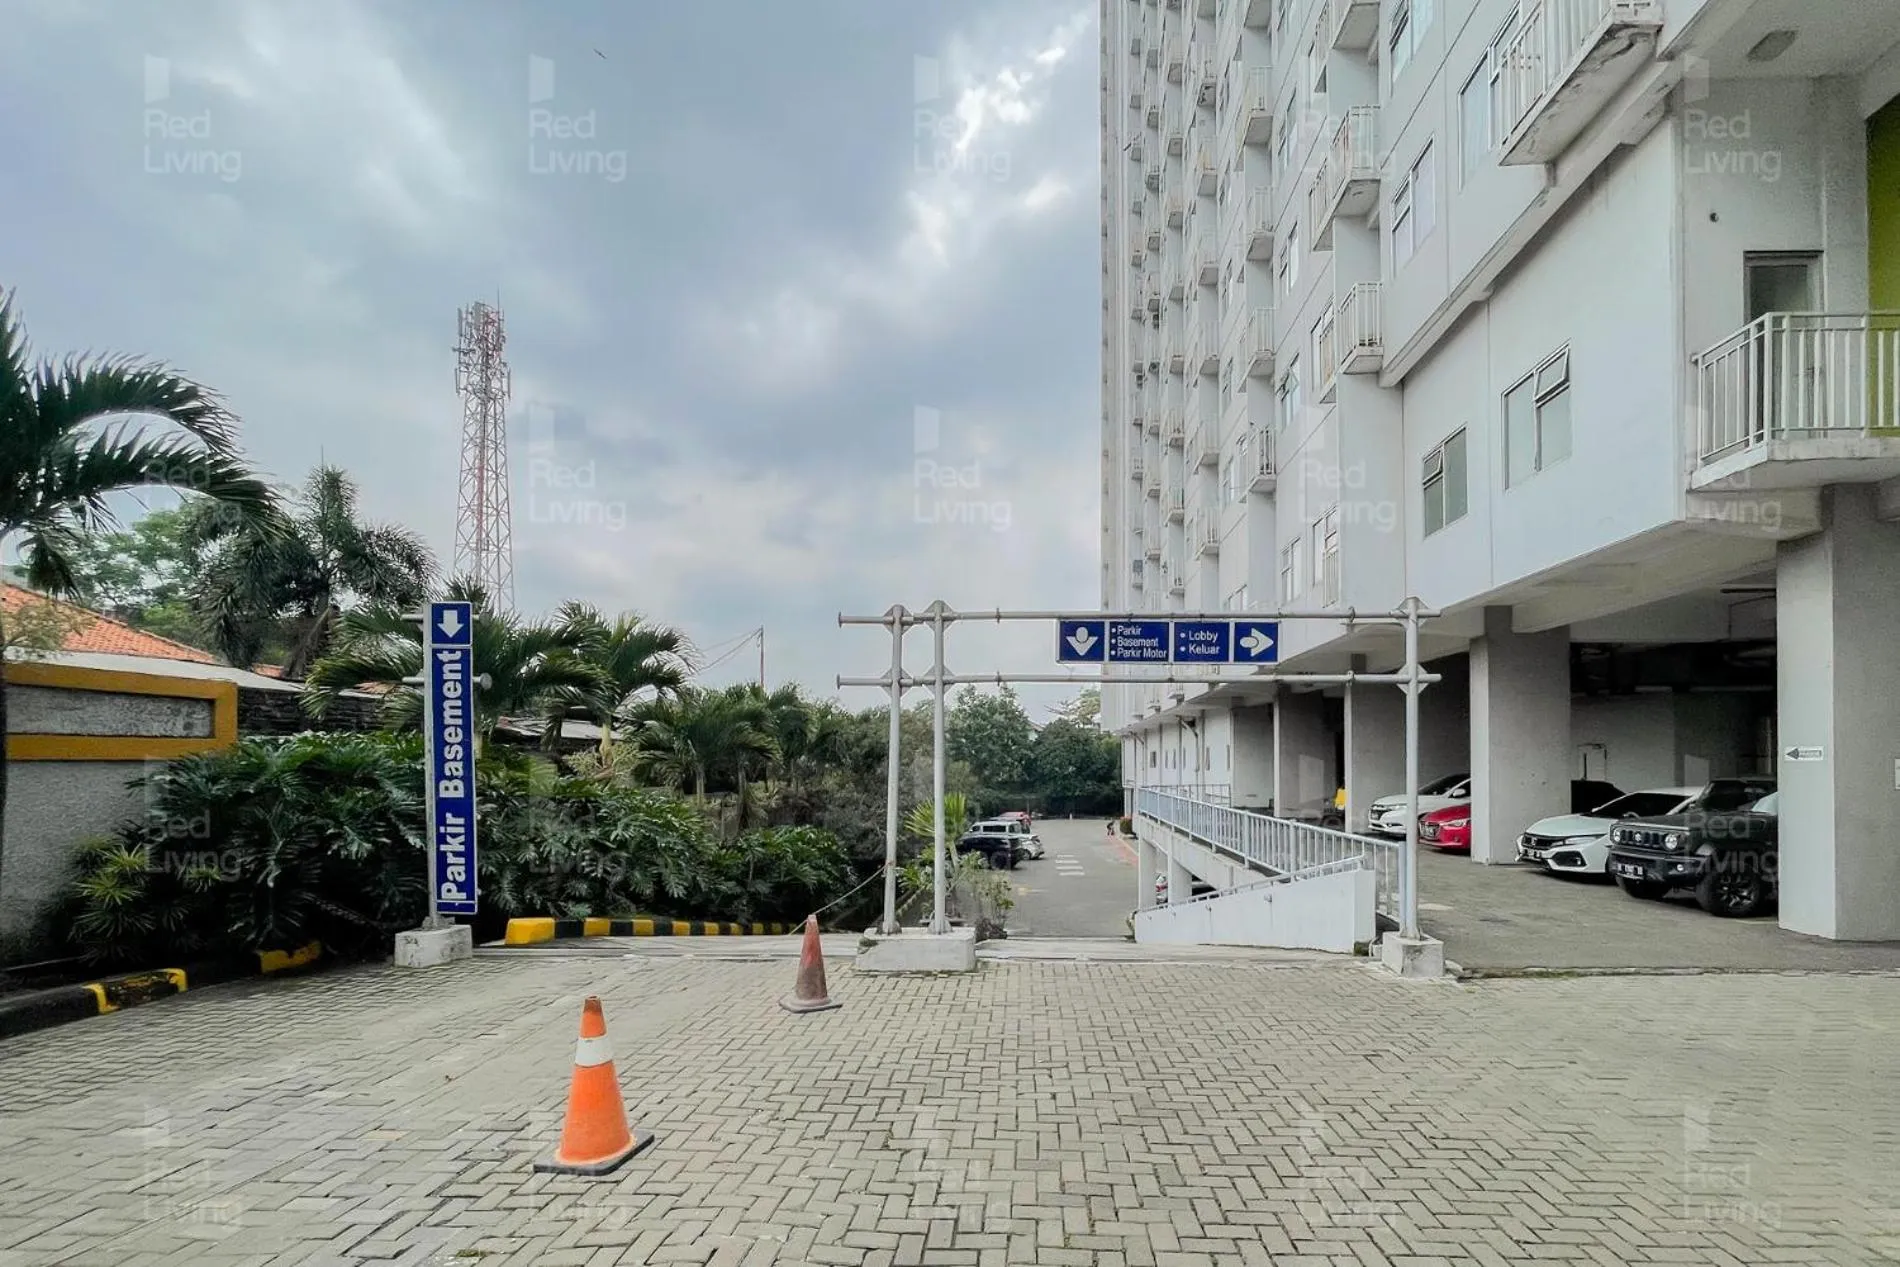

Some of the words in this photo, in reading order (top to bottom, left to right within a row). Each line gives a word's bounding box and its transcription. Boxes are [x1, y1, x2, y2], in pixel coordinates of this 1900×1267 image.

[1117, 625, 1142, 635] Parkir
[1188, 629, 1218, 642] Lobby
[1117, 637, 1159, 647] Basement
[1117, 648, 1142, 658] Parkir
[1143, 648, 1167, 659] Motor
[1188, 643, 1220, 655] Keluar
[436, 650, 465, 798] Basement
[440, 812, 467, 900] Parkir
